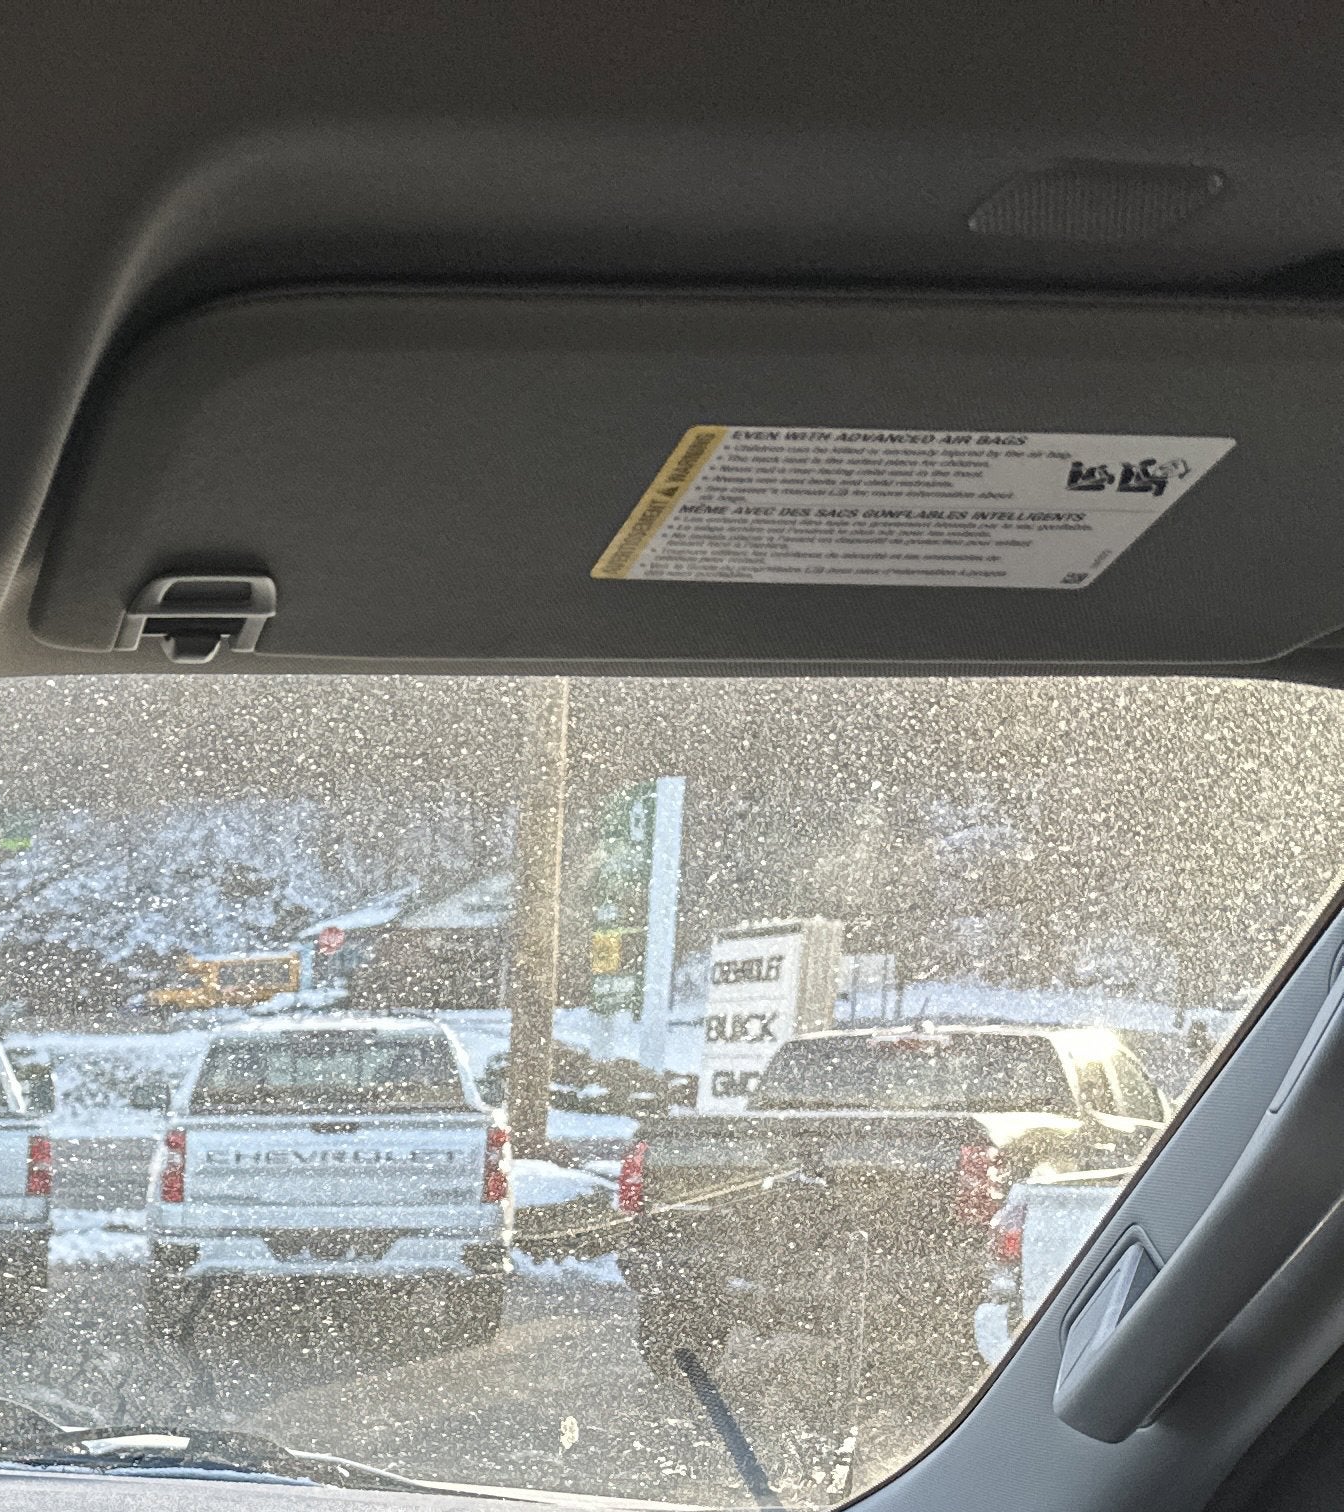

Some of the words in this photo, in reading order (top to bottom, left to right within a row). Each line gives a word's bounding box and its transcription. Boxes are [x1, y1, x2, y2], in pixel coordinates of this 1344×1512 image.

[732, 430, 780, 441] EVEN
[939, 434, 972, 445] AIR
[975, 435, 1028, 446] BAGS
[705, 1012, 778, 1043] BUICK
